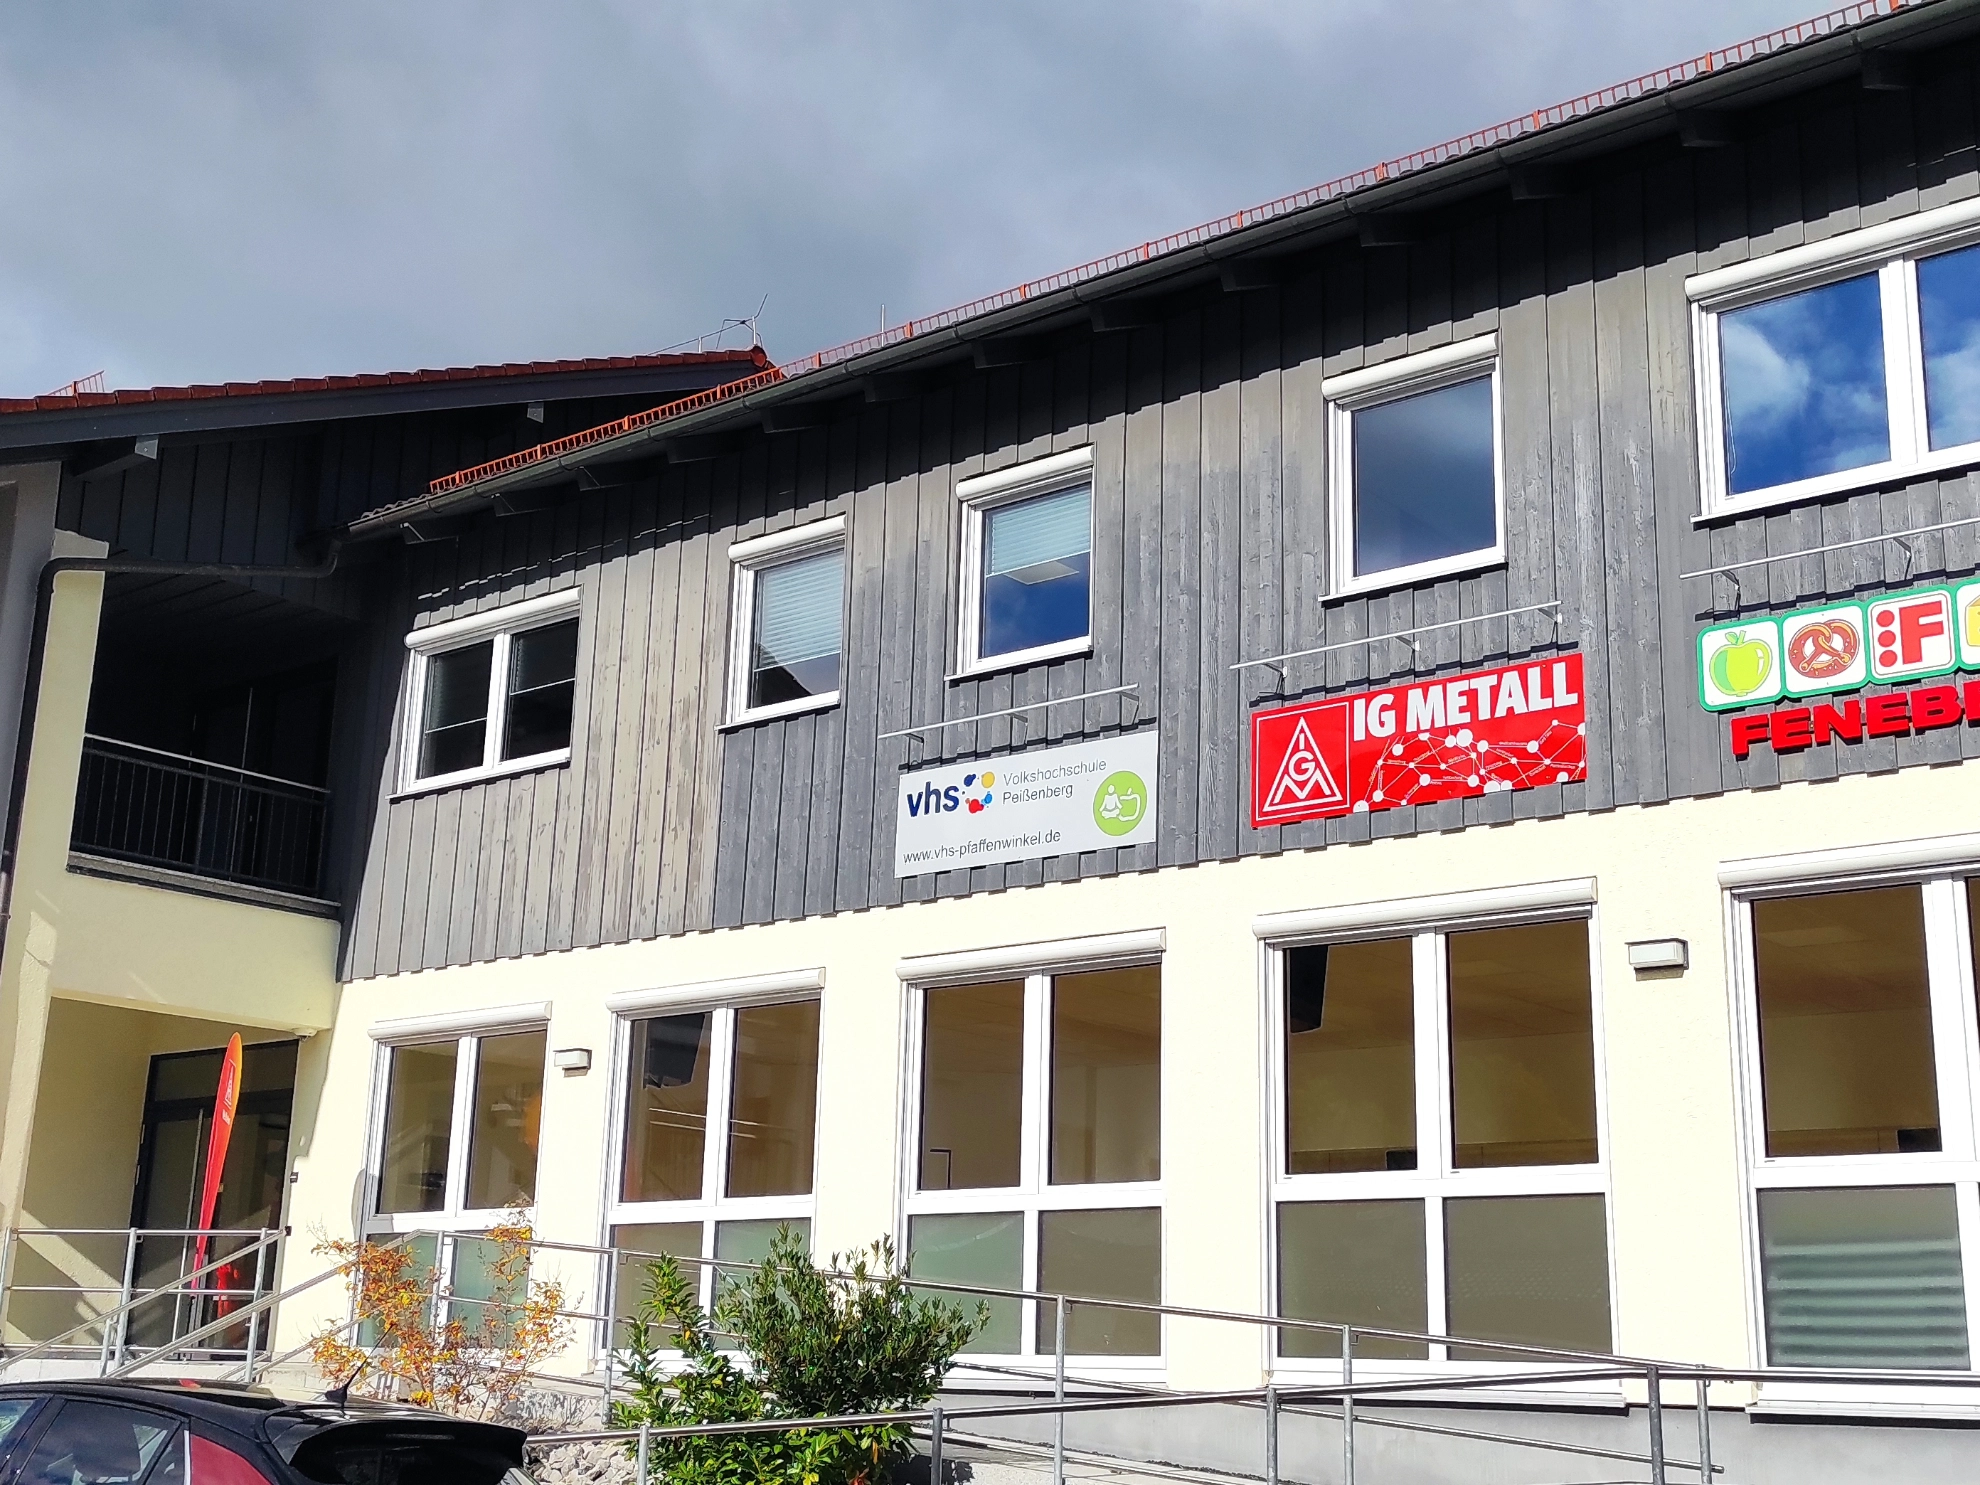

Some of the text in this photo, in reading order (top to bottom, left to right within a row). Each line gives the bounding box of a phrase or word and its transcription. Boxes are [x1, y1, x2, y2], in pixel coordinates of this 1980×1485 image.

[1353, 661, 1579, 742] IG METALL
[1002, 758, 1107, 787] Volkshochschule
[906, 780, 960, 818] vhs
[1002, 783, 1074, 805] Peißenberg
[902, 829, 1062, 864] www.vhs-pfaffenwinkel.de
